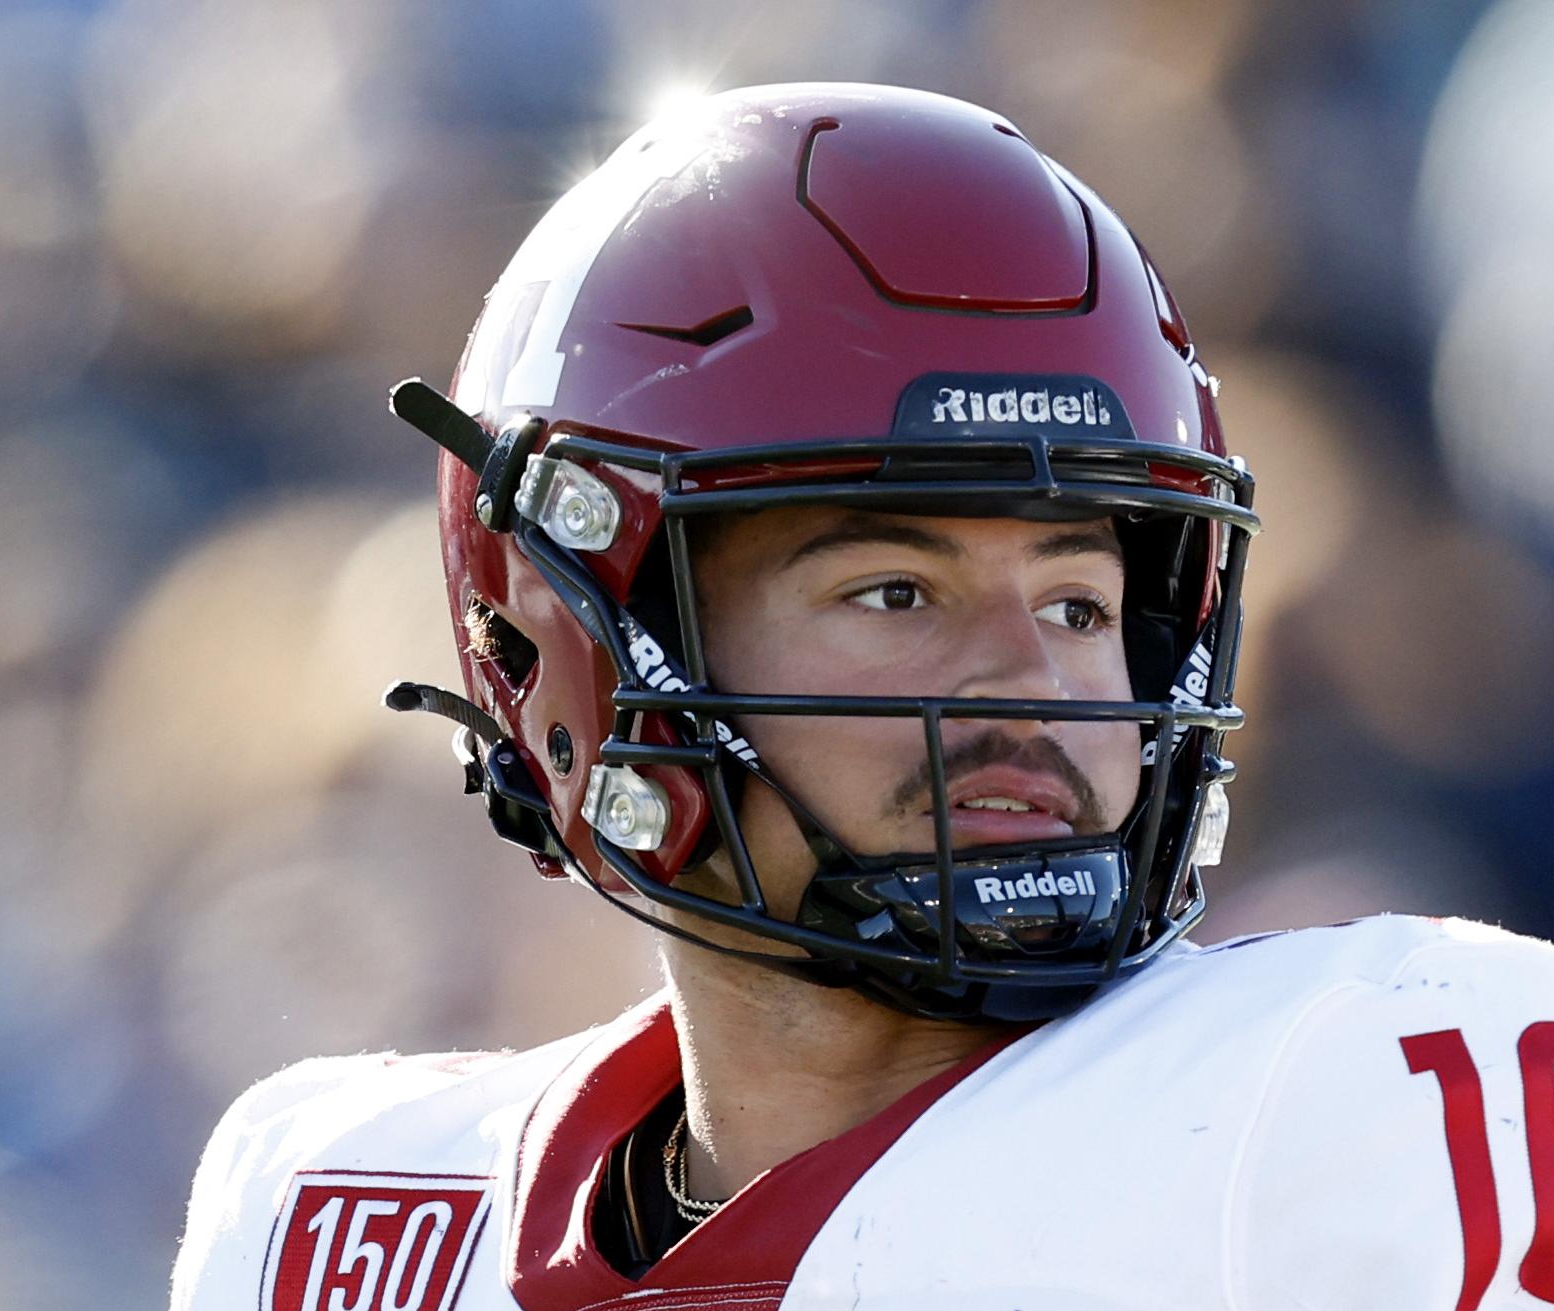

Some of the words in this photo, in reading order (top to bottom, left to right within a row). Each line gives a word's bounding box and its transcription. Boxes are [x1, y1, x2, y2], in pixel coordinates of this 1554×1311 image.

[932, 387, 1112, 425] Riddell
[628, 633, 760, 763] Riell
[1140, 642, 1213, 767] Rdell
[973, 870, 1097, 904] Riddell
